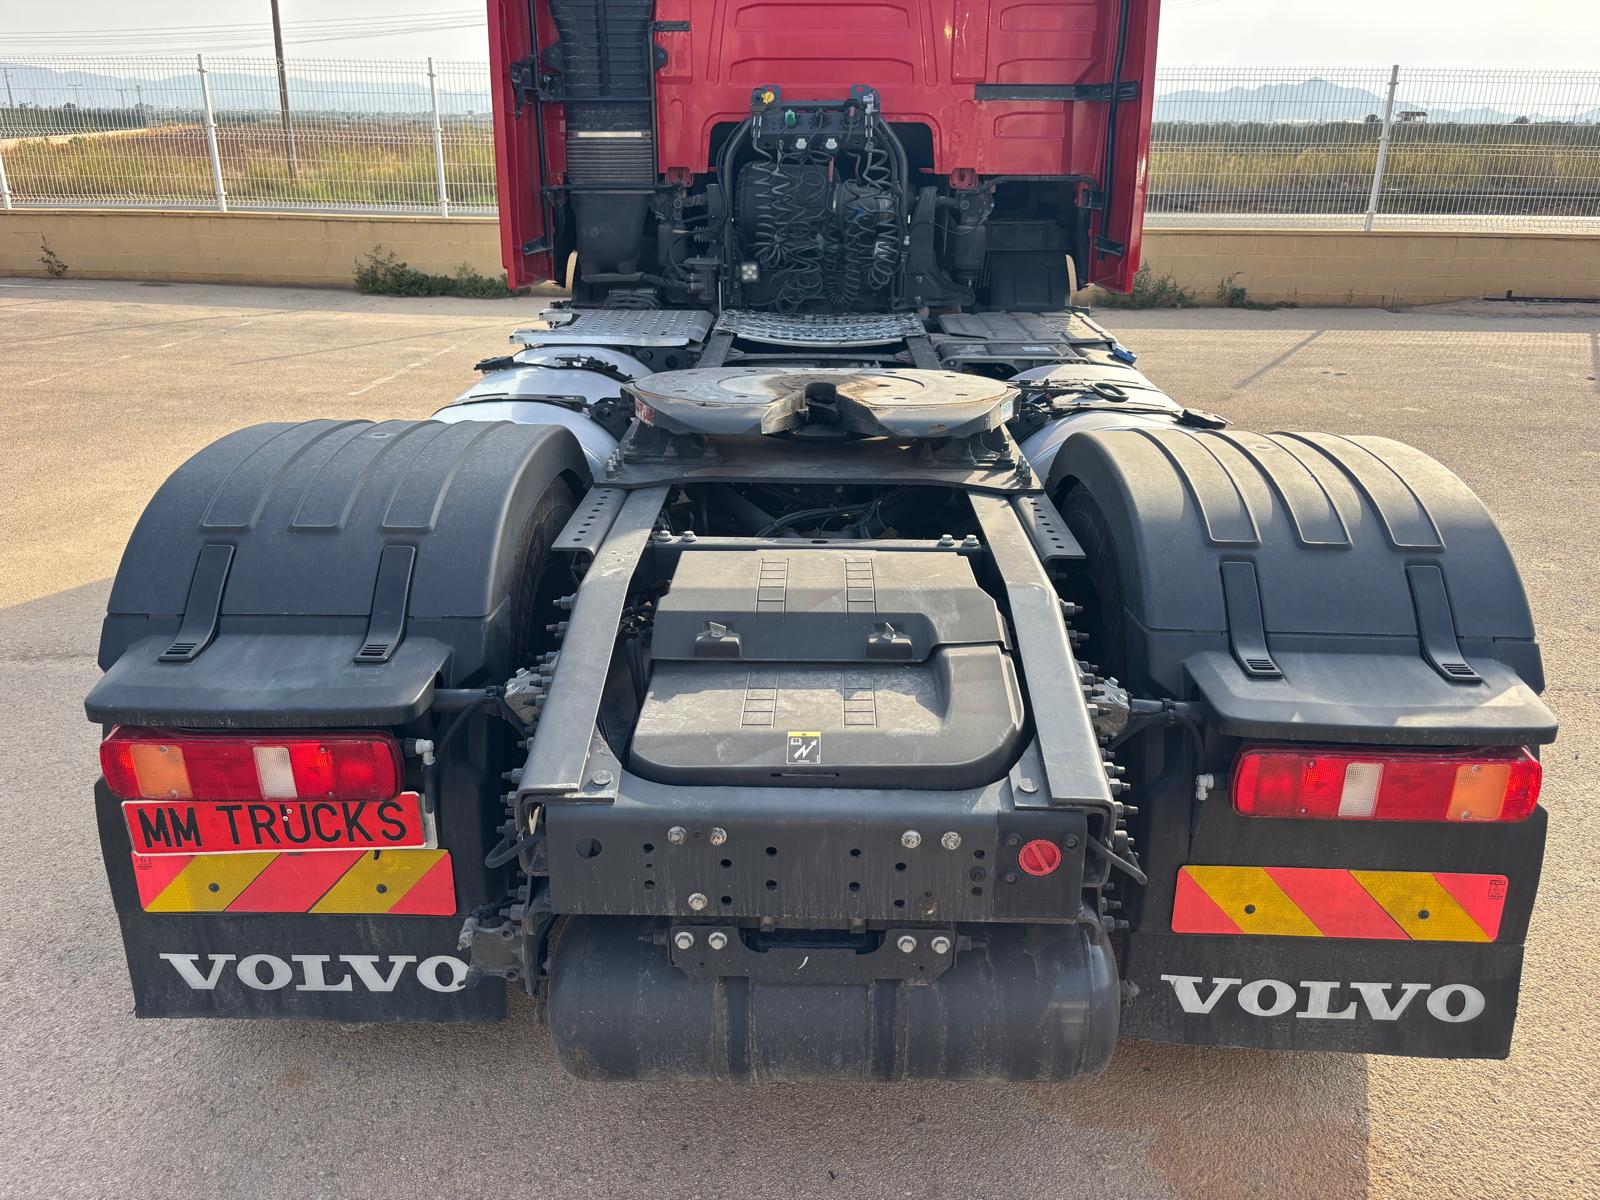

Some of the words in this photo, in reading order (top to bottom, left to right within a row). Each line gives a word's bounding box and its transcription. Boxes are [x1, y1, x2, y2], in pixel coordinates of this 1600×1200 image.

[137, 807, 203, 848] MM
[215, 801, 407, 845] TRUCKS
[159, 953, 470, 992] VOLVO
[1160, 974, 1486, 1023] VOLVO
